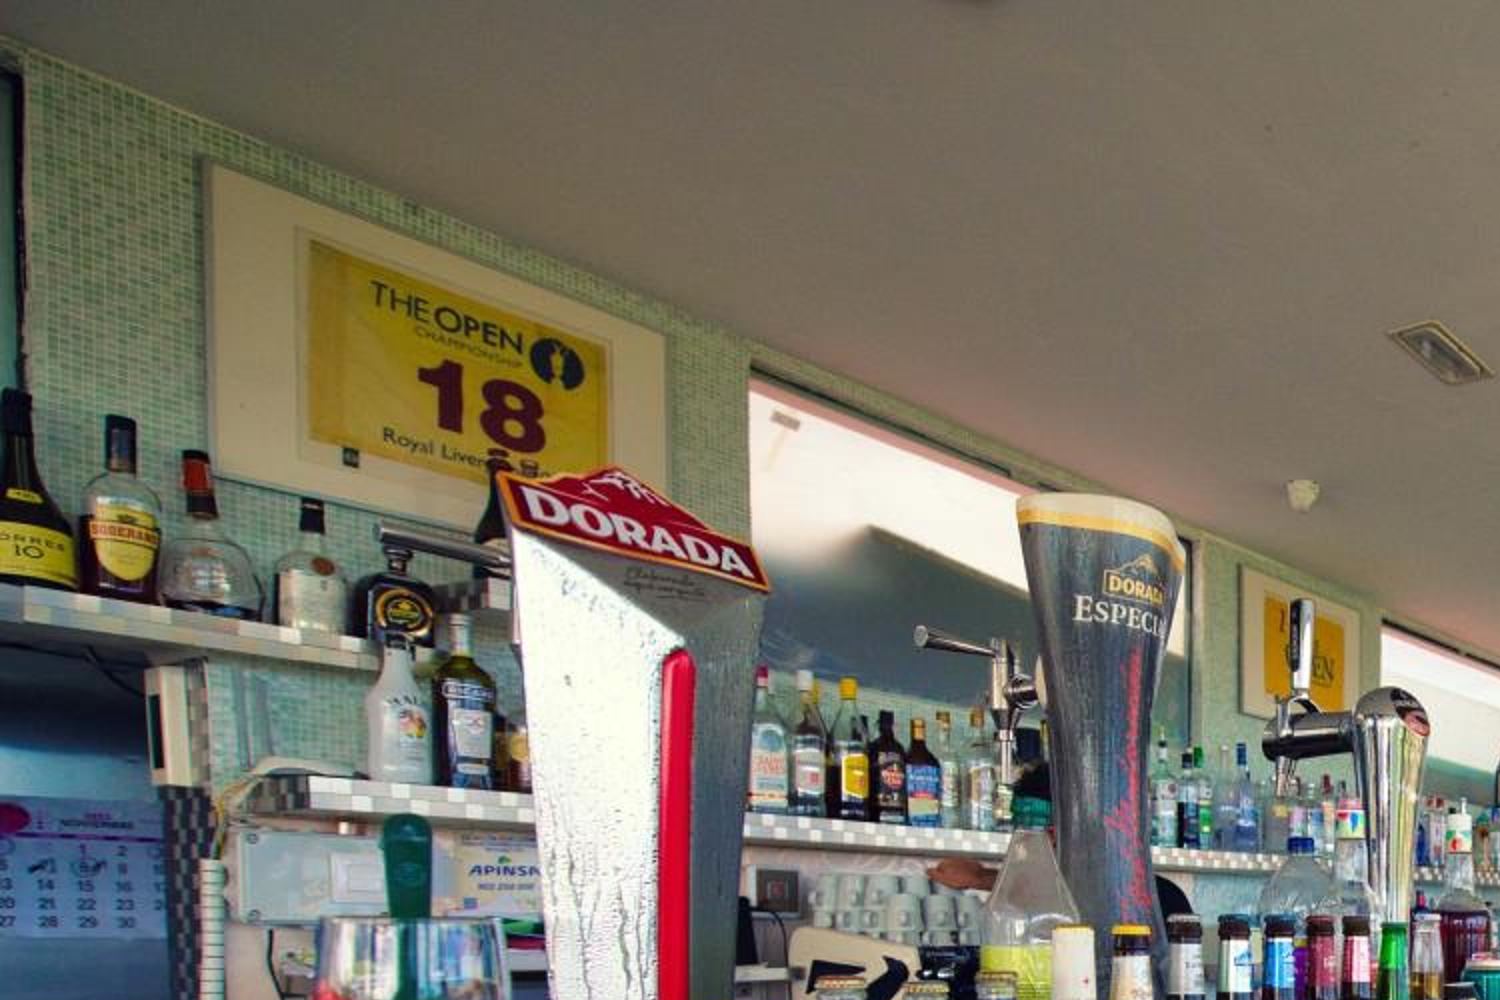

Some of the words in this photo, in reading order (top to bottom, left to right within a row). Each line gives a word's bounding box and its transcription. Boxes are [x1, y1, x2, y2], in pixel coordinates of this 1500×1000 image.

[370, 281, 433, 322] THE
[434, 306, 523, 355] OPEN
[382, 427, 434, 456] Royal
[418, 359, 546, 454] 18
[519, 485, 756, 579] DORADA
